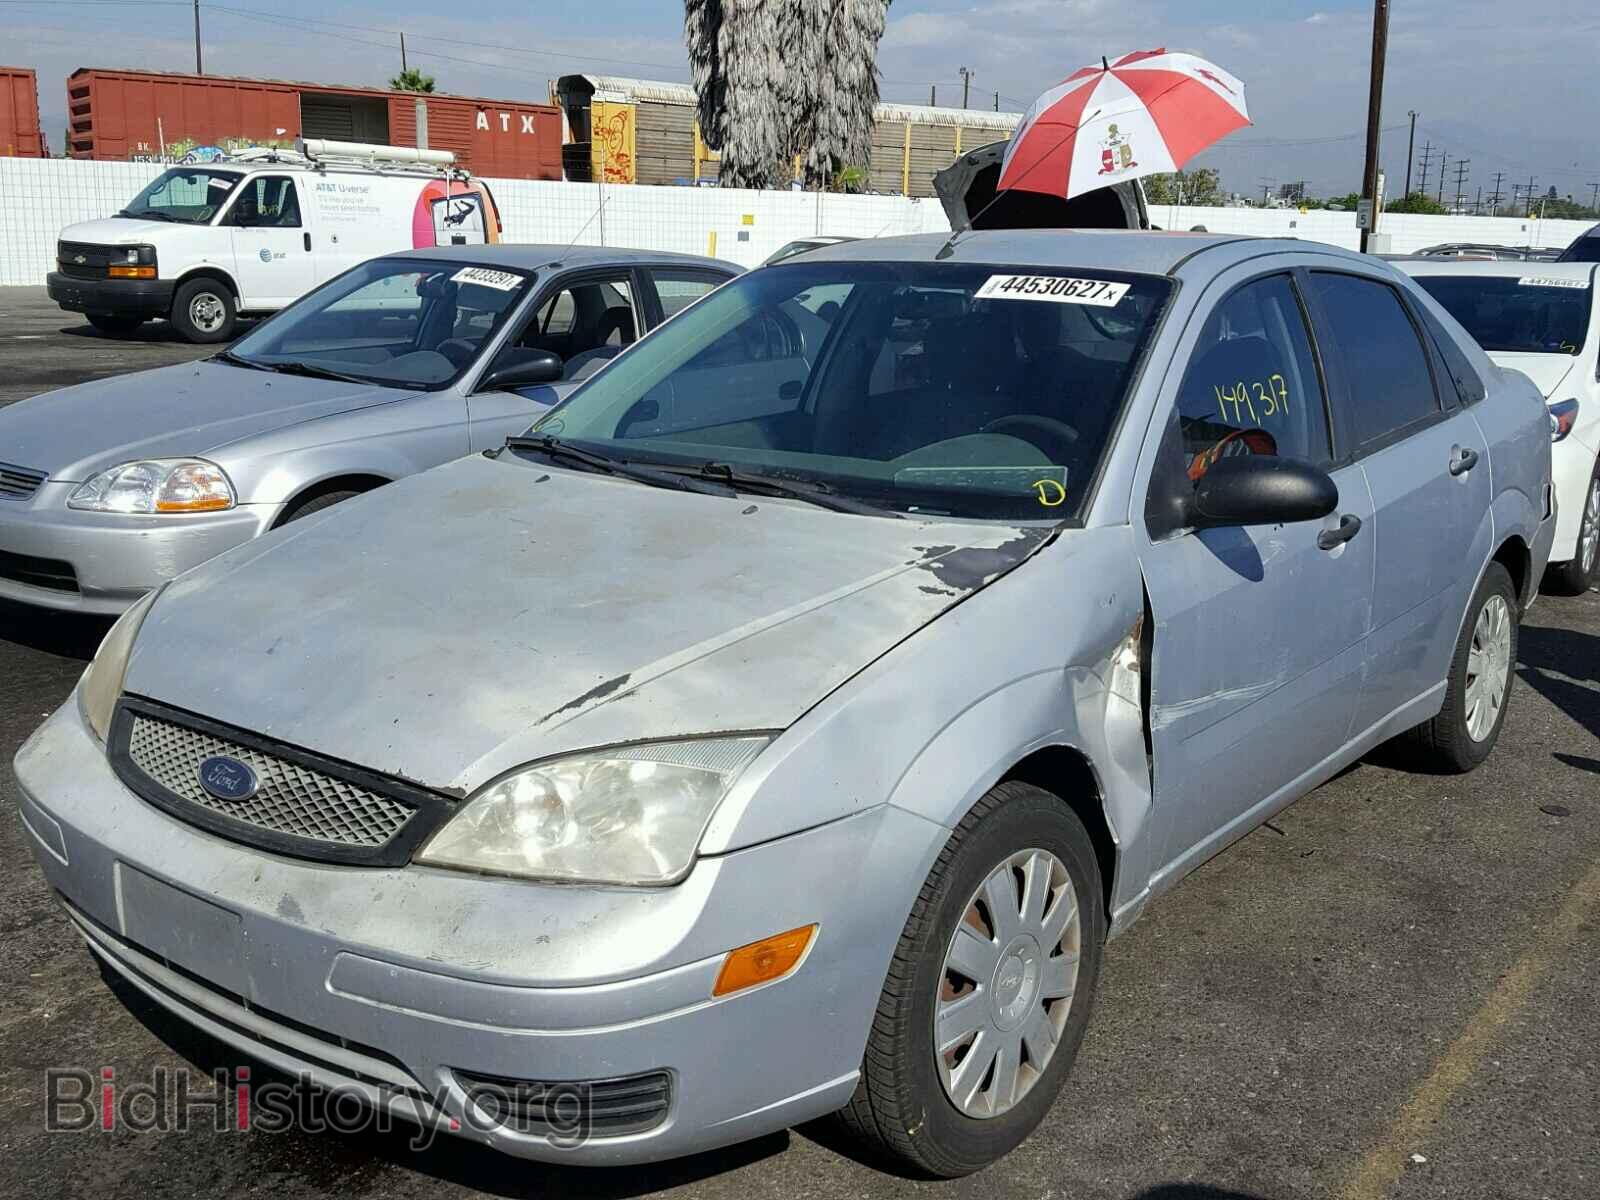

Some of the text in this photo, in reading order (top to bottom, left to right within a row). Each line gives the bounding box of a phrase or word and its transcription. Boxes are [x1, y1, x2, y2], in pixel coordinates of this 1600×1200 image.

[316, 183, 336, 192] AT&T
[1360, 214, 1367, 225] 5
[1213, 374, 1289, 428] 149,317
[1032, 479, 1066, 506] D
[207, 763, 242, 791] Ford
